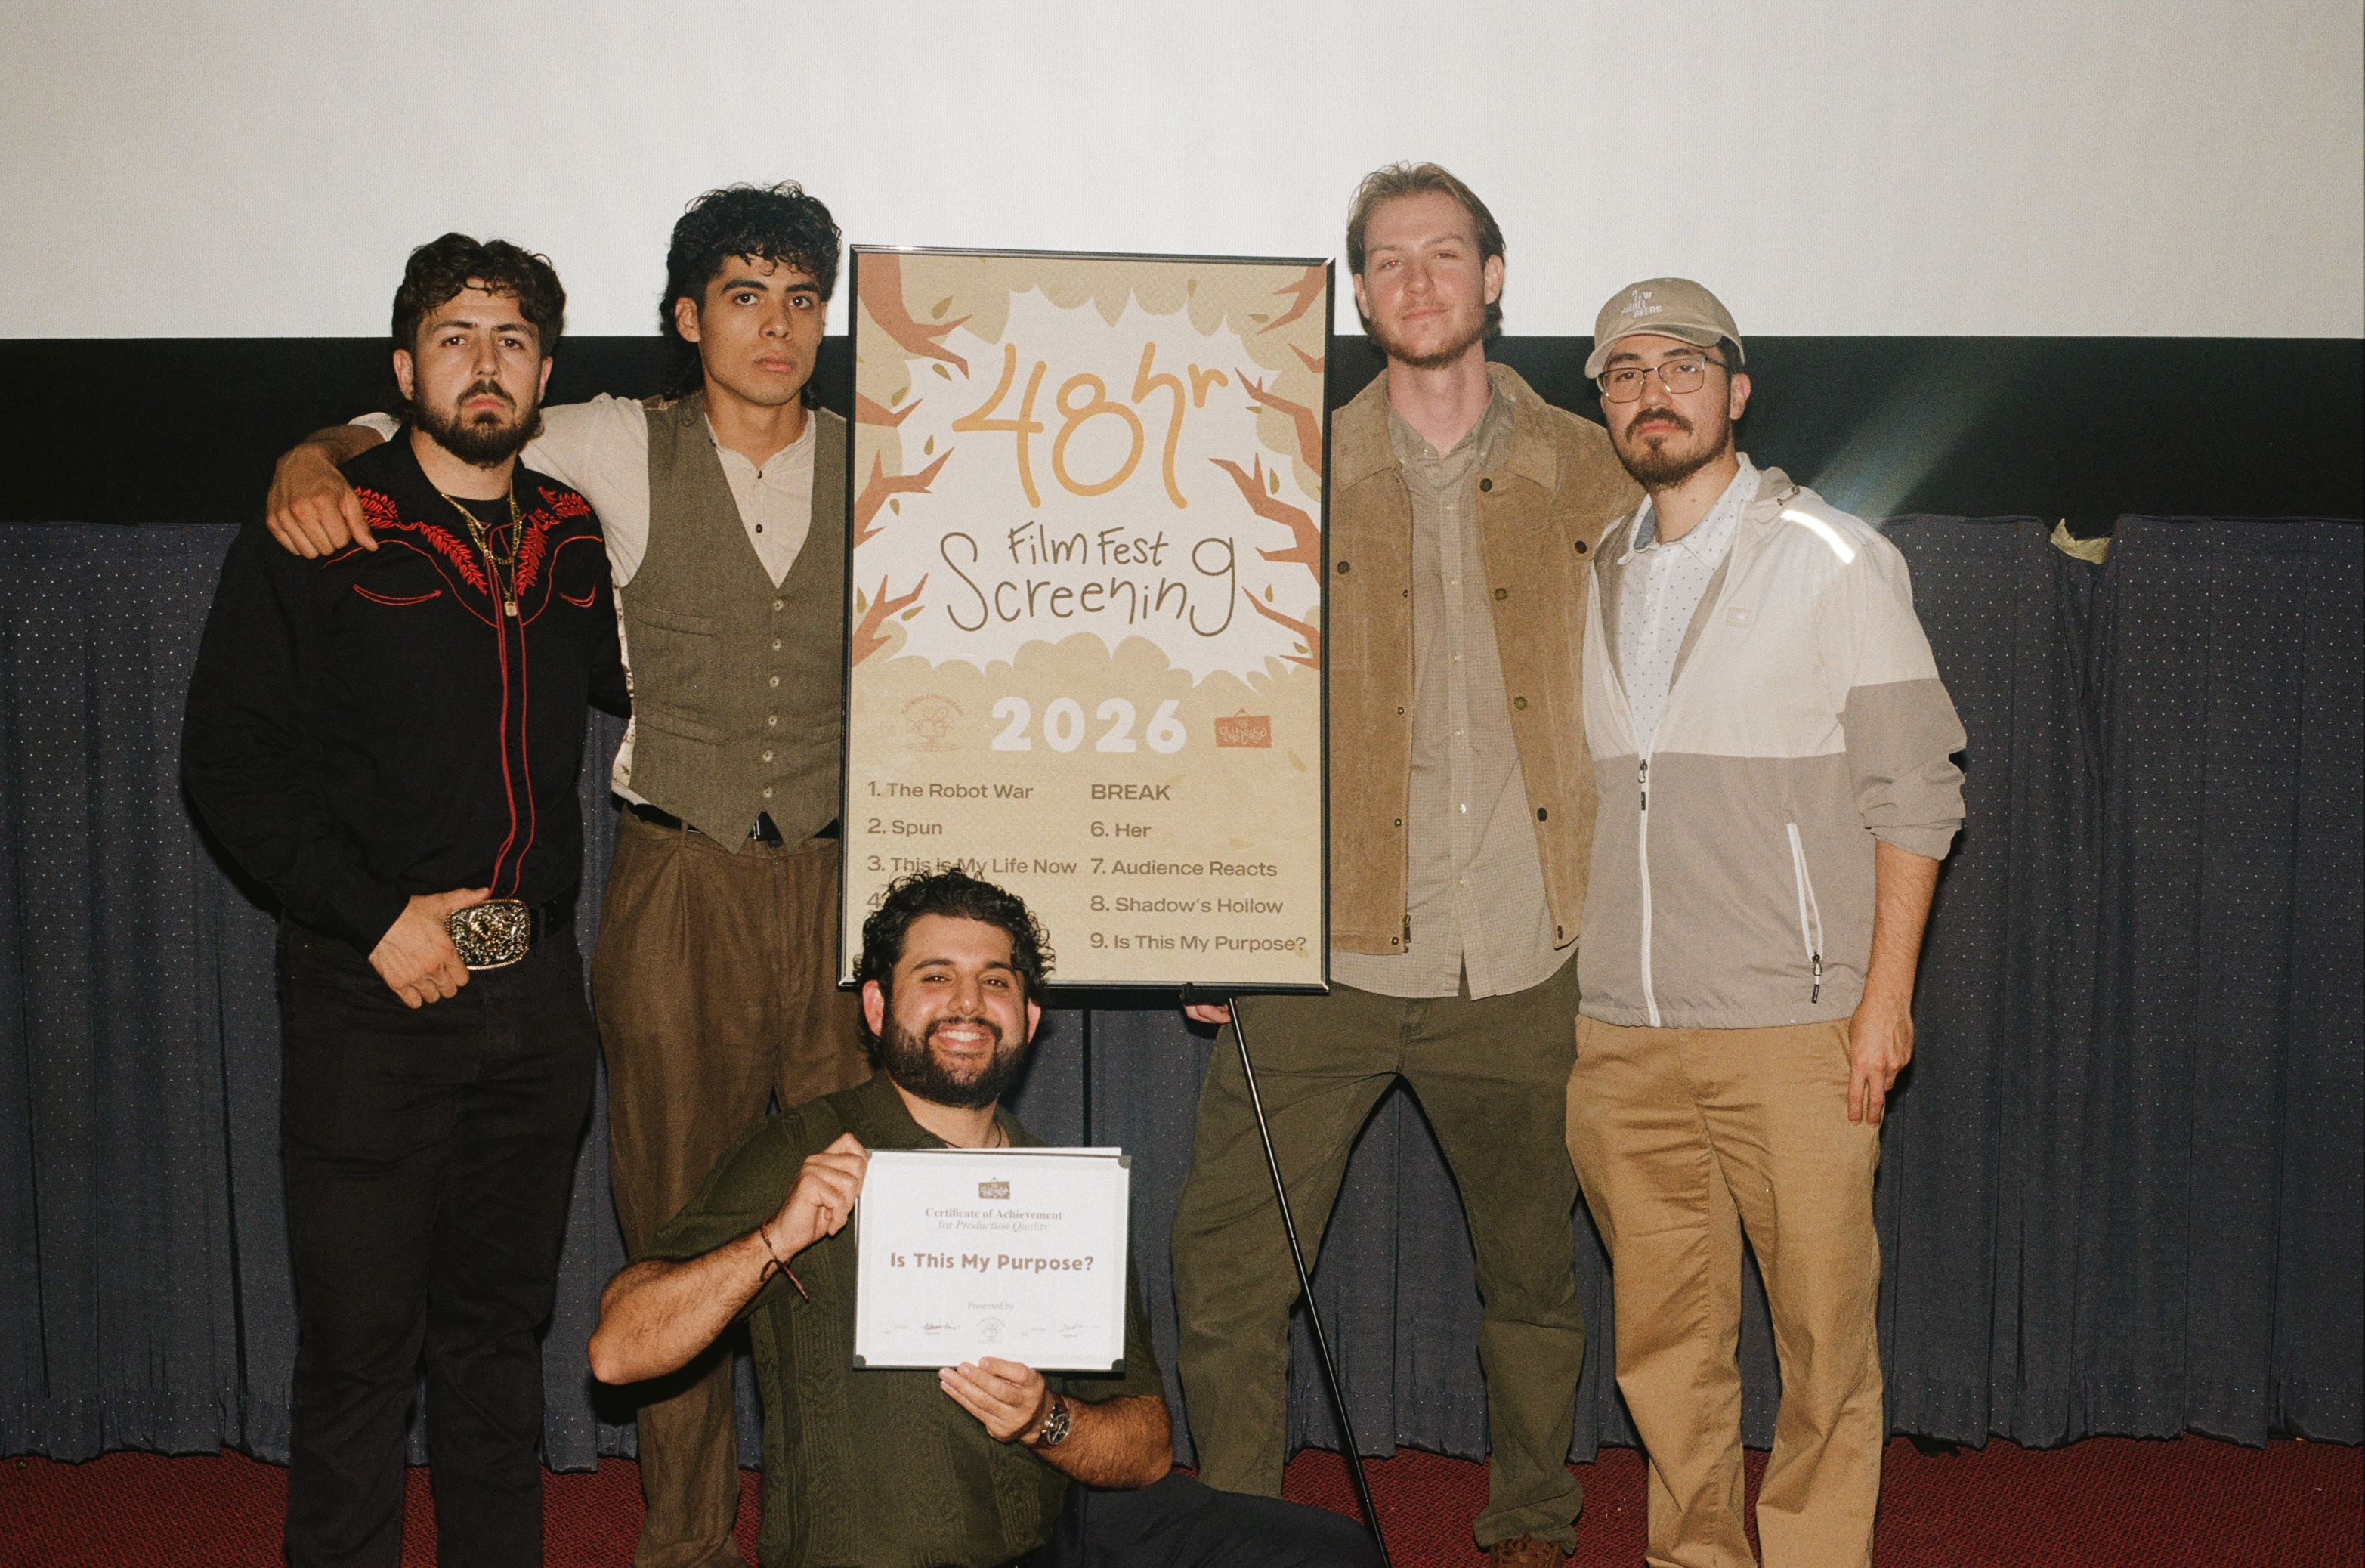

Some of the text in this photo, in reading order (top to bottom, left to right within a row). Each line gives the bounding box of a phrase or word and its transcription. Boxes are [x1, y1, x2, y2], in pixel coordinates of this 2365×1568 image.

[951, 342, 1229, 509] 48hr
[1009, 521, 1169, 568] Film Fest
[940, 531, 1237, 638] Screening
[991, 696, 1188, 754] 2026
[868, 781, 1034, 799] 1. The Robot War
[1091, 784, 1170, 801] BREAK
[867, 818, 943, 837] 2. Spun
[1090, 821, 1152, 837] 6. Her
[867, 855, 1077, 875] 3. This is My Life Now
[1090, 858, 1278, 877] 7. Audience Reacts
[1090, 895, 1110, 912] 8.
[1217, 898, 1284, 914] Hollow
[1090, 932, 1306, 953] 9. Is This My Purpose?
[926, 1208, 1062, 1220] Certificate of Achievement
[938, 1220, 1050, 1232] for Production Quality
[890, 1252, 1095, 1274] Is This My Purpose?
[968, 1301, 1014, 1311] Presented by
